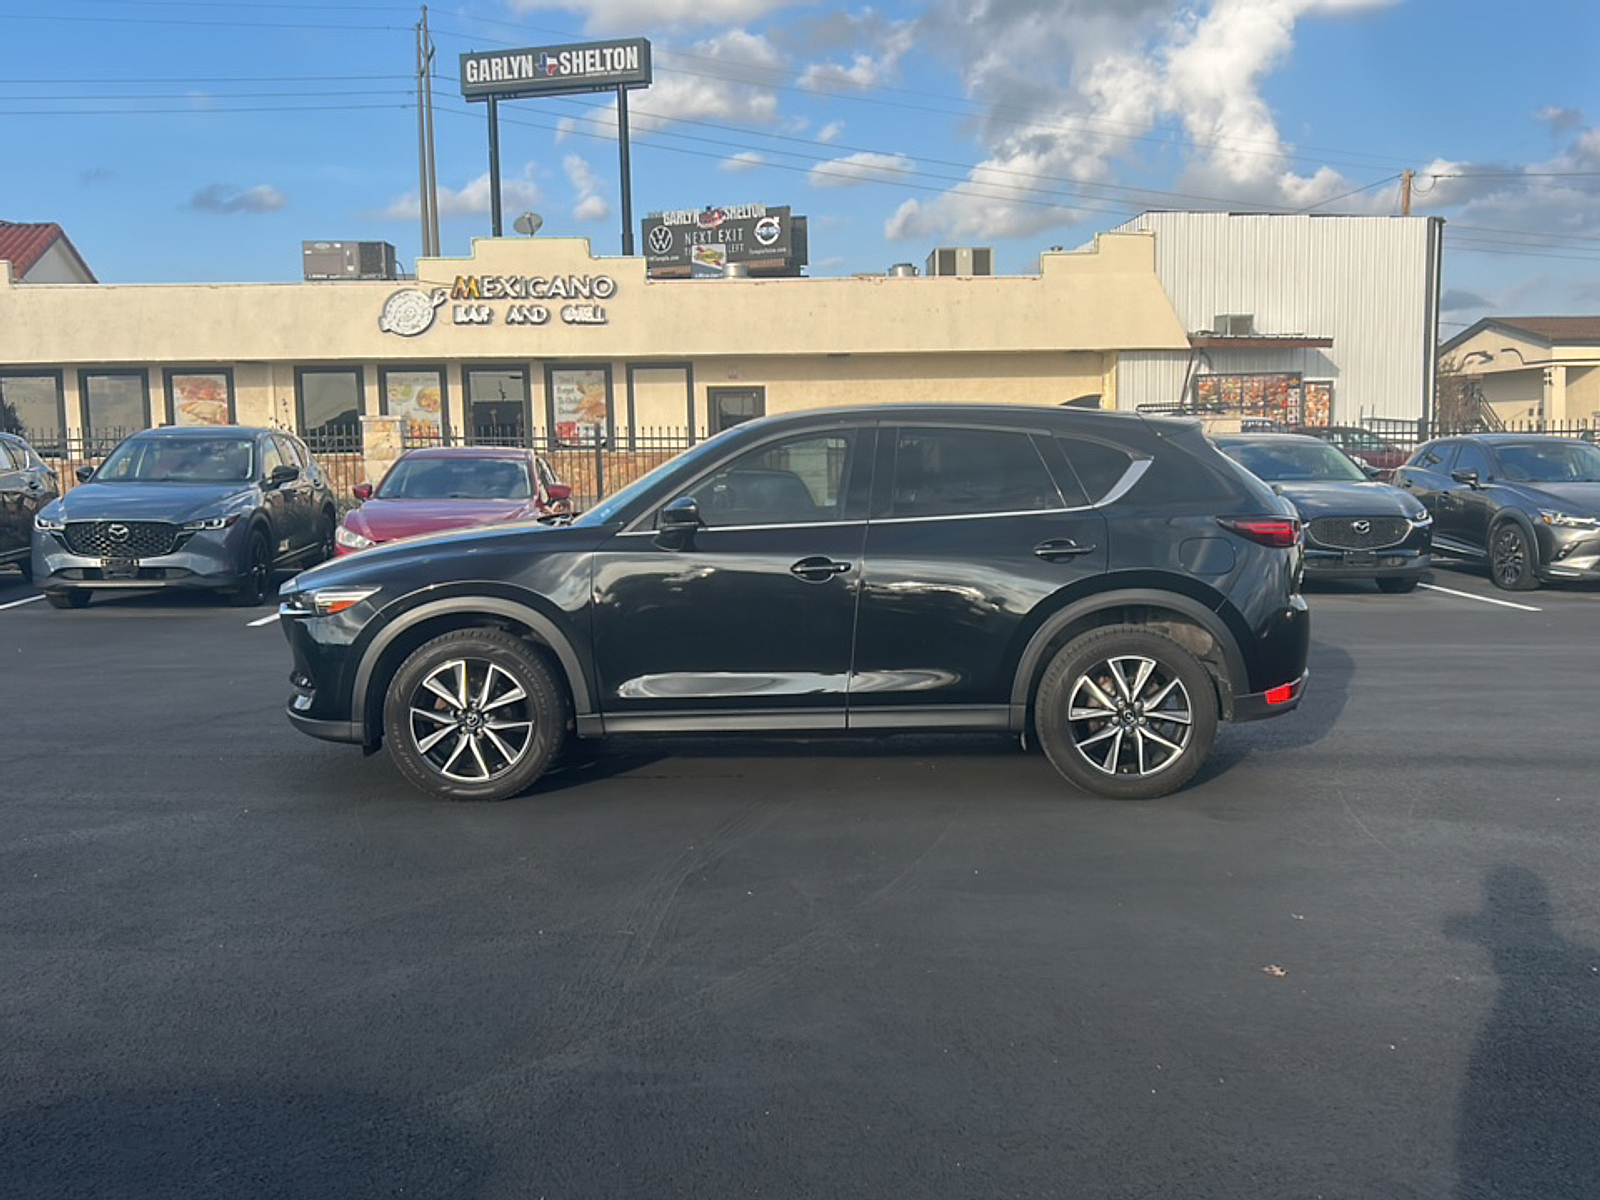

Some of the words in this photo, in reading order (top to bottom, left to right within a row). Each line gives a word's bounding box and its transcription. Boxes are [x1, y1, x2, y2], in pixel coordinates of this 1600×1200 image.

[466, 54, 533, 82] GARLYN
[559, 46, 638, 75] SHELTON
[684, 230, 712, 245] NEXT
[718, 228, 743, 243] EXIT
[452, 275, 617, 299] MEXICANO
[506, 304, 551, 324] AND
